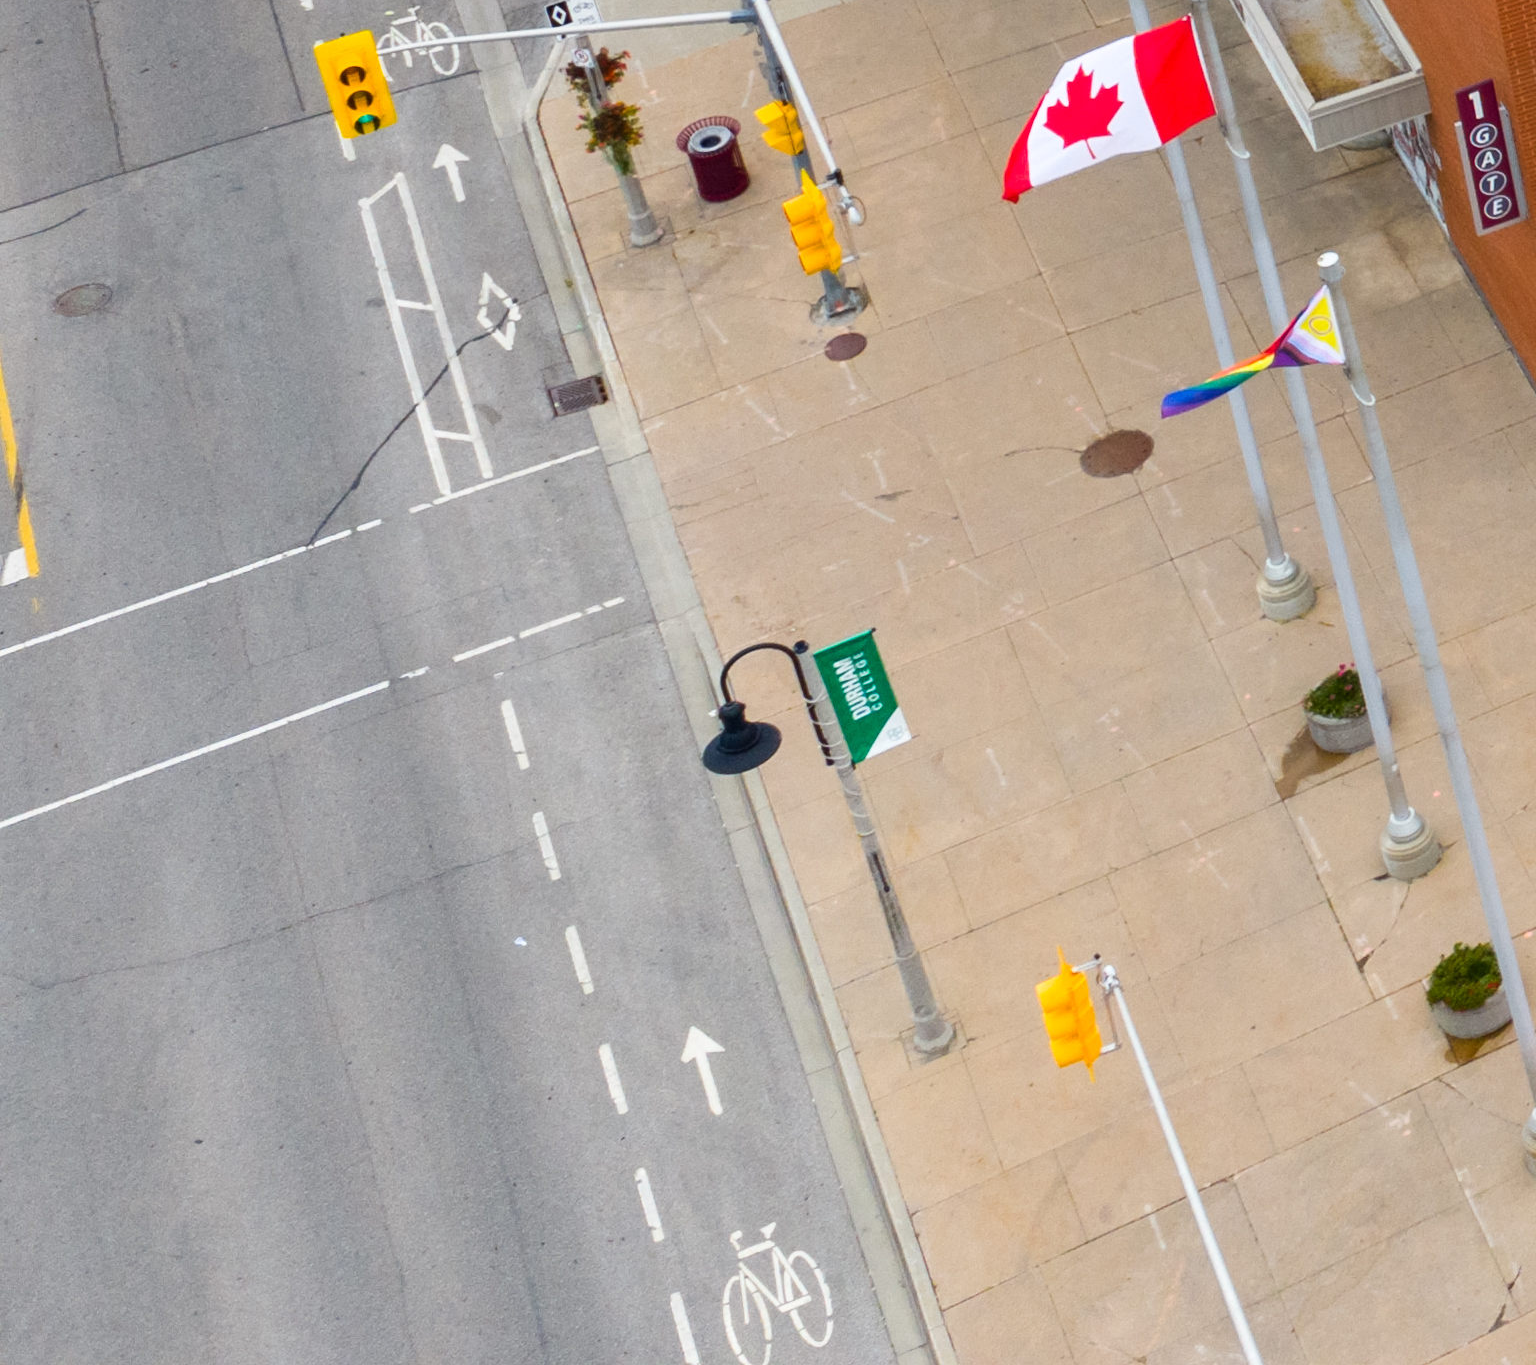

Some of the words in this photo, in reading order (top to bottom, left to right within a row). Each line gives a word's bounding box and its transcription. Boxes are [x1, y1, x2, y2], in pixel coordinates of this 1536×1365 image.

[1468, 90, 1485, 120] 1
[1475, 126, 1505, 217] GATE
[832, 656, 872, 721] DURHAM
